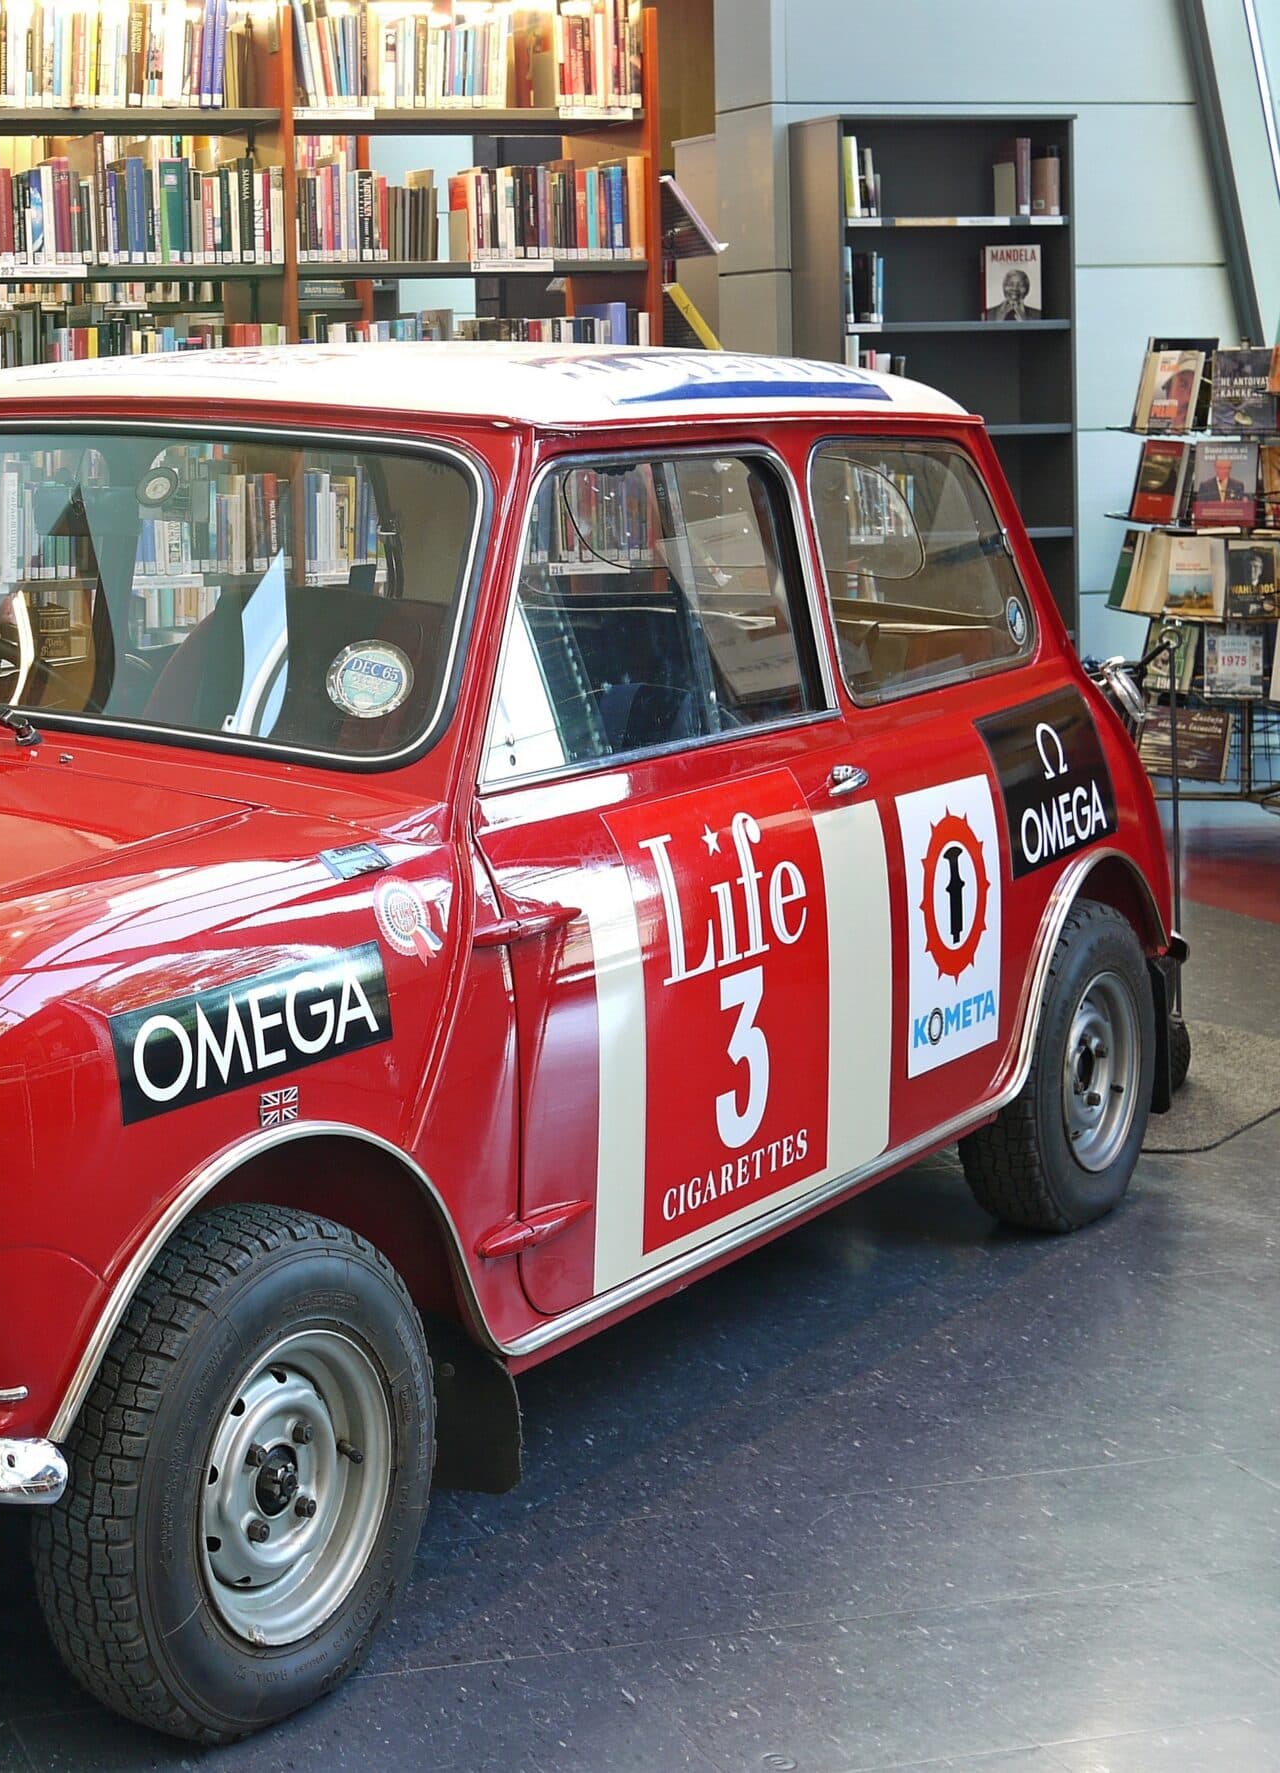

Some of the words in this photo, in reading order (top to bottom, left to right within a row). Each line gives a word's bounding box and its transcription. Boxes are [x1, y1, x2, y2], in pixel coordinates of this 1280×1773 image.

[241, 169, 250, 200] SUMMA
[991, 248, 1037, 263] MANDELA
[351, 658, 382, 676] DEC
[382, 667, 400, 681] 65
[1221, 655, 1247, 666] 1975
[1021, 779, 1108, 864] OMEGA
[639, 811, 808, 986] Life
[133, 963, 380, 1102] OMEGA
[913, 988, 996, 1049] KOMETA
[716, 966, 770, 1149] 3
[663, 1128, 808, 1221] CIGARETTES
